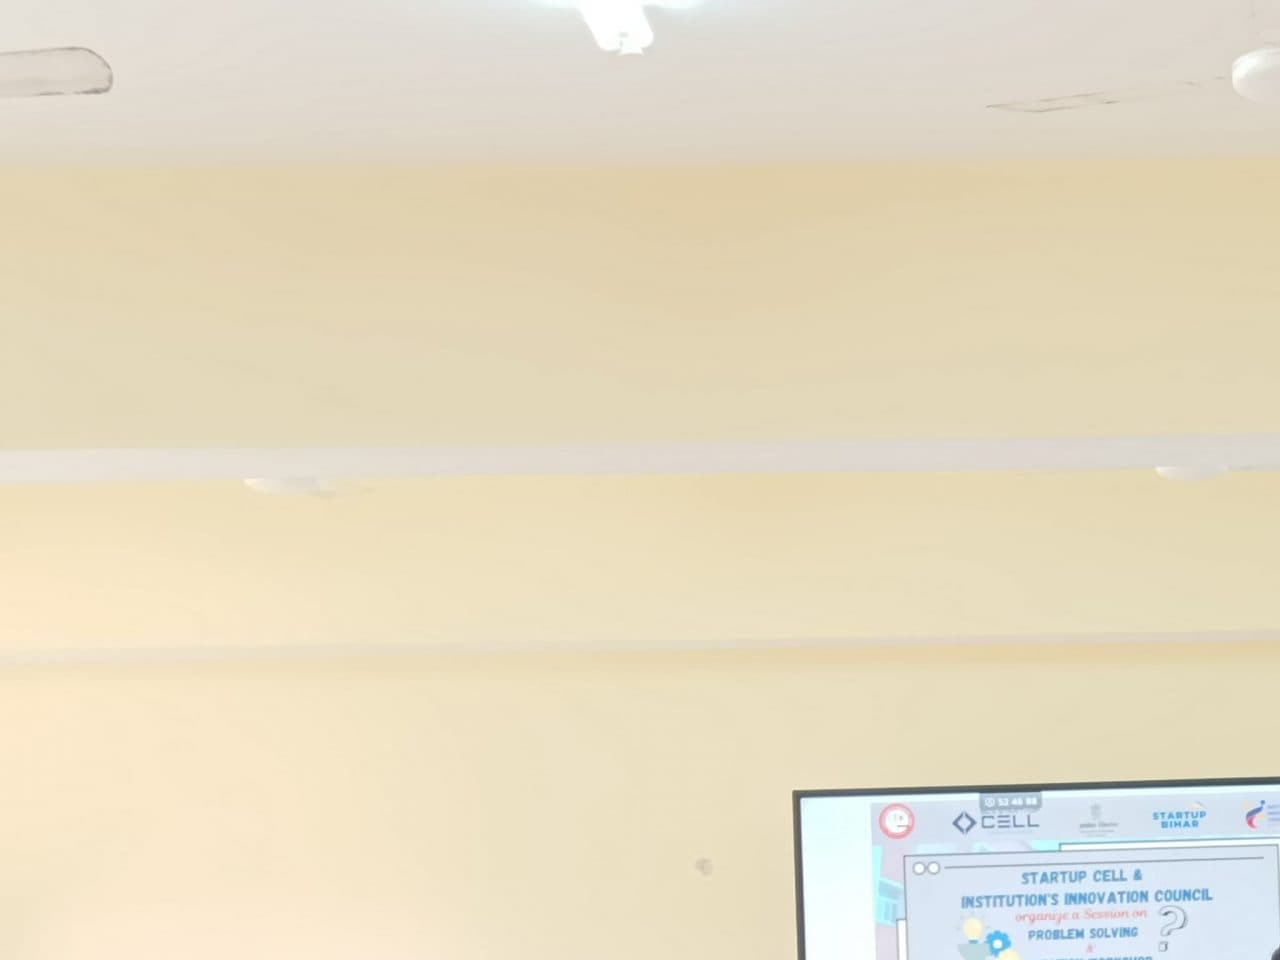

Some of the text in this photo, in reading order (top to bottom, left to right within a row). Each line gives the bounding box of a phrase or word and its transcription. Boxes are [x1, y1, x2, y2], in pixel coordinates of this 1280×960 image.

[981, 814, 1040, 829] CELL
[1152, 810, 1207, 821] STARTUP
[1161, 819, 1199, 829] BIHAR
[1021, 868, 1143, 885] STARTUP CELL &
[961, 888, 1213, 909] INSTITUTION'S INNOVATION COUNCIL
[1015, 909, 1069, 925] organize
[1083, 908, 1129, 919] Session
[1132, 909, 1147, 918] on
[1028, 926, 1139, 940] PROBLEM SOLVING
